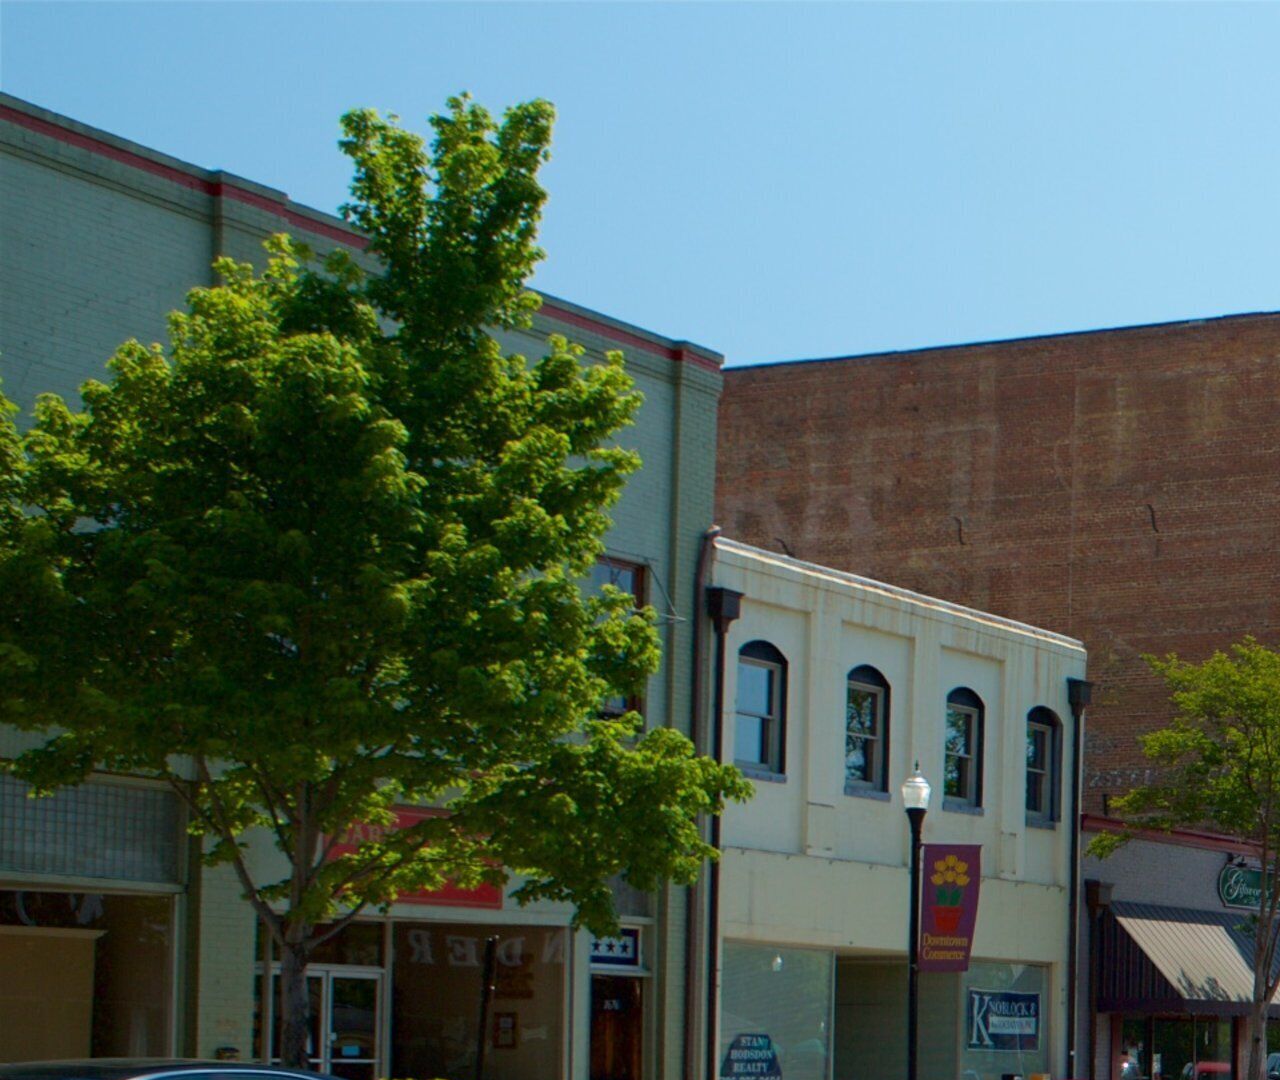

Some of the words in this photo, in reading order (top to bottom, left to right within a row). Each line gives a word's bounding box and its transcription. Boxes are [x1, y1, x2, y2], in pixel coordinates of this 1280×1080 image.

[923, 933, 968, 946] Downtown
[923, 946, 965, 960] Commerce
[740, 1036, 764, 1047] STAN
[733, 1062, 768, 1073] REALTY
